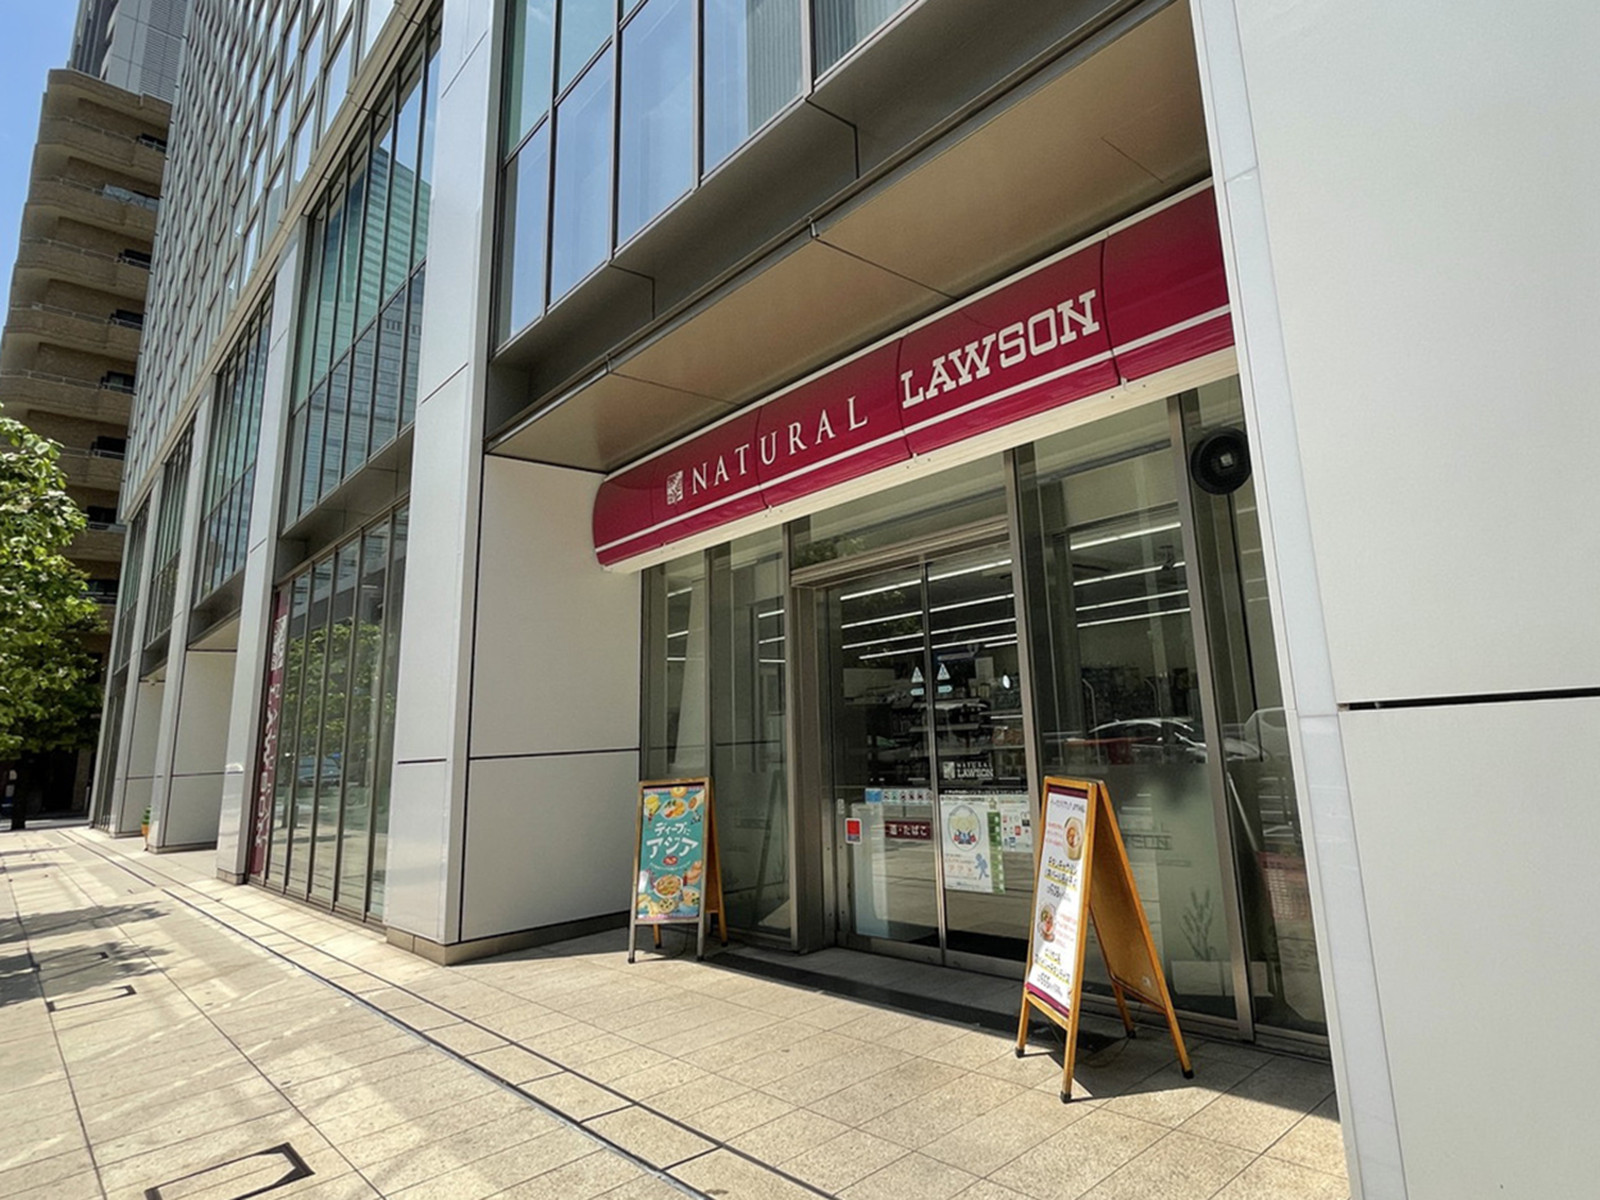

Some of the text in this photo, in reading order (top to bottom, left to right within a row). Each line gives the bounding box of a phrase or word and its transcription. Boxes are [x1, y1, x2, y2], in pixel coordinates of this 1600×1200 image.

[692, 289, 1101, 495] NATURAL LAWSON
[957, 769, 994, 778] LAWSON
[646, 836, 699, 859] アジア
